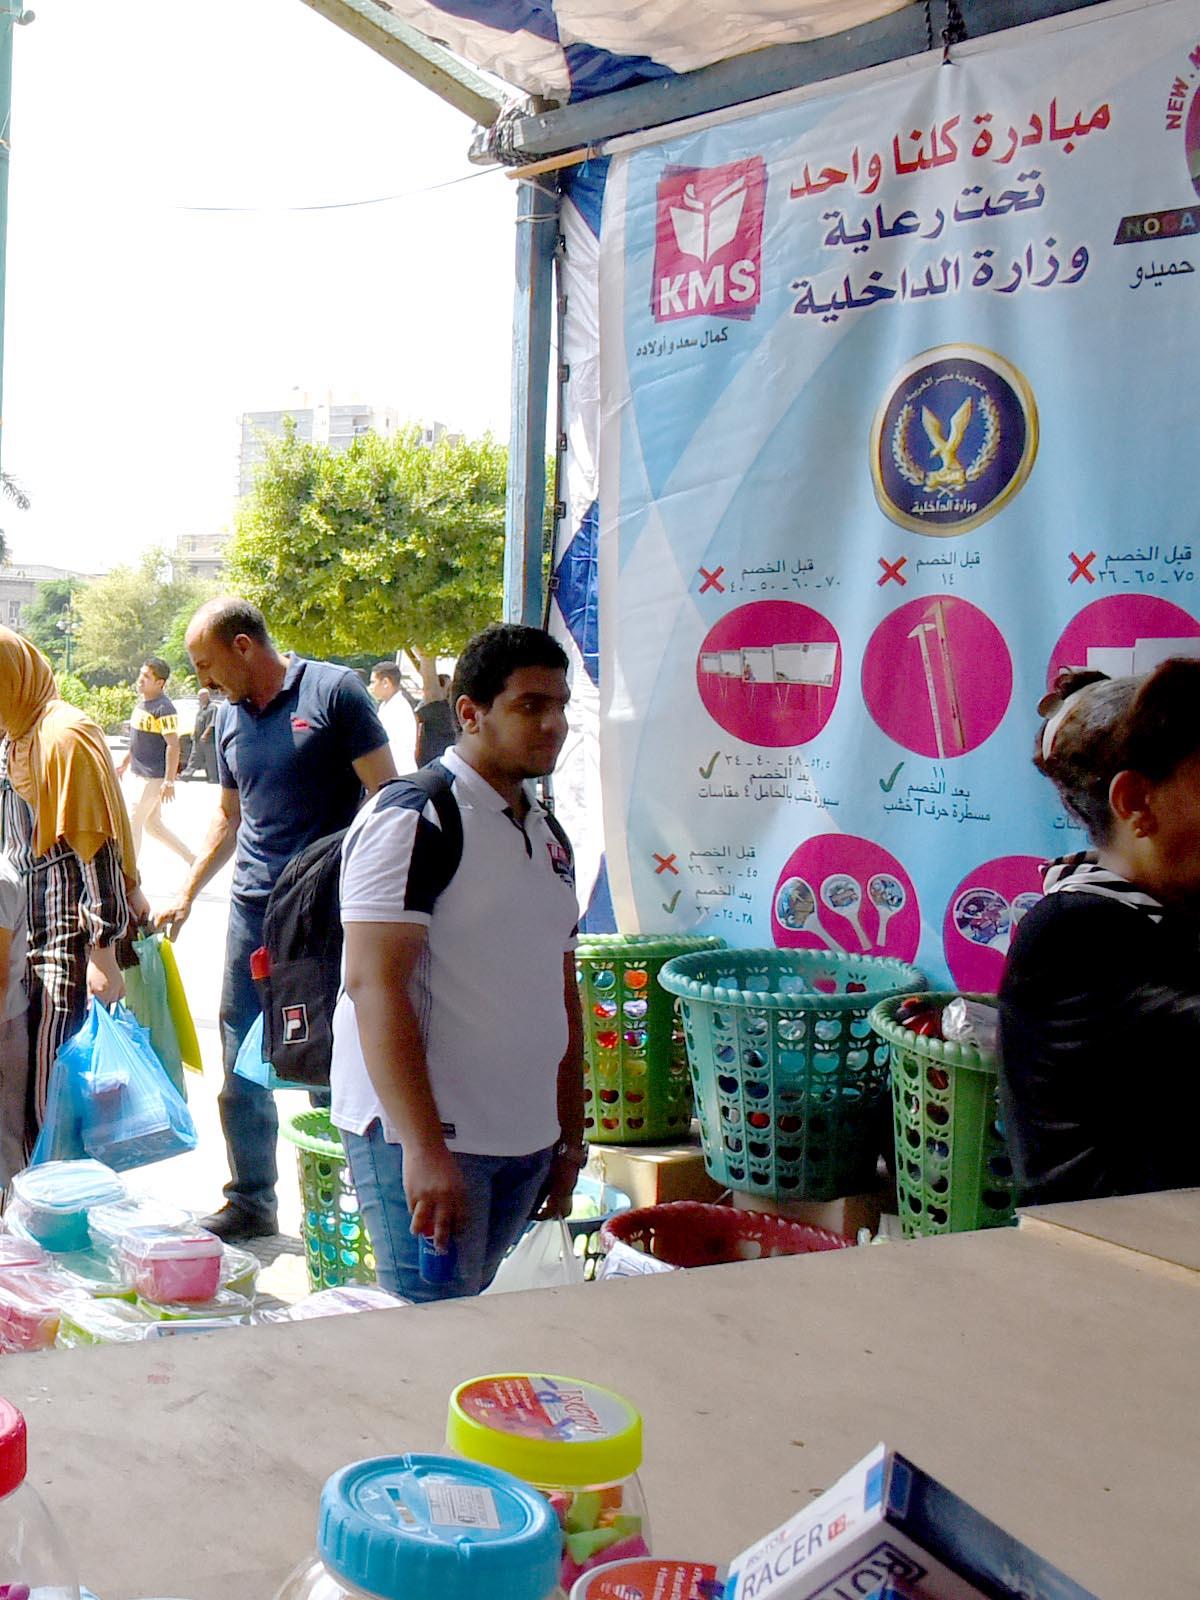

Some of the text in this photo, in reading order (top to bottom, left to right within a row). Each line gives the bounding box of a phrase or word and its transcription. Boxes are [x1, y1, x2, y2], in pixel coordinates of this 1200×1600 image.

[790, 96, 1111, 200] مبادرة كلنا واحد
[823, 169, 1045, 254] تحت رعاية
[659, 258, 757, 317] KMS
[792, 237, 1090, 323] وزارة الداخلية
[700, 326, 729, 349] كمال
[912, 499, 978, 516] وزارة الداخلية
[915, 552, 981, 574] قبل الخصم
[1104, 545, 1193, 569] قبل الخصم
[741, 558, 815, 582] قبل الخصم
[749, 767, 793, 785] الخصم
[698, 784, 740, 799] مقاسات
[907, 781, 971, 802] بعد الخصم
[883, 798, 913, 816] خشب
[952, 800, 991, 824] مسطرة
[689, 845, 756, 861] قبل الخصم
[695, 884, 735, 901] الخصم
[740, 1523, 824, 1600] RACER
